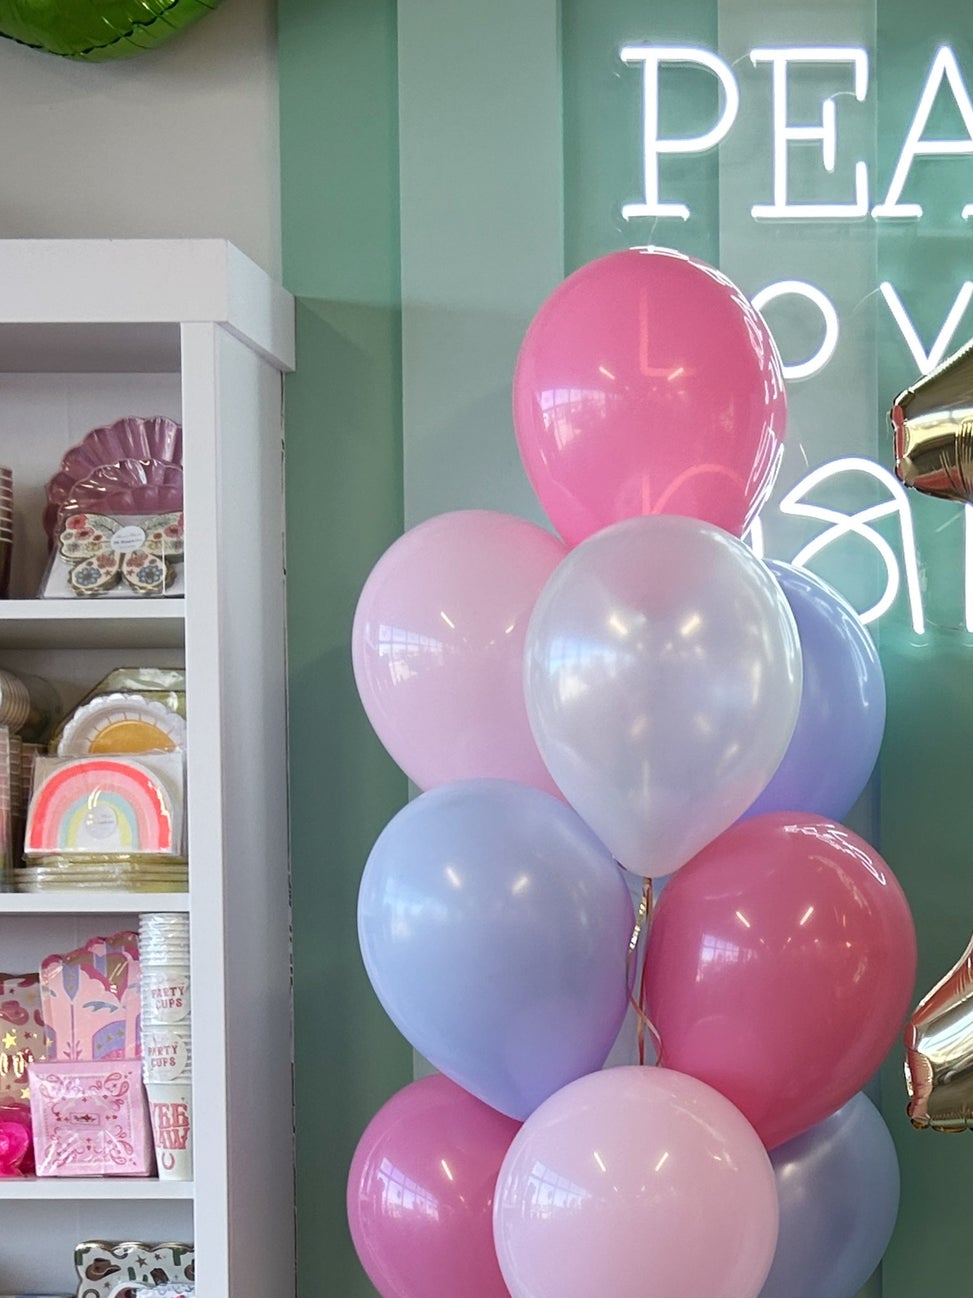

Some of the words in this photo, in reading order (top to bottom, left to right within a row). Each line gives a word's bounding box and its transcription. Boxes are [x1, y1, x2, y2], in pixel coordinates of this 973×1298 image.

[151, 986, 185, 999] PARTY
[156, 998, 183, 1009] CUPS
[148, 1044, 179, 1056] PARTY
[151, 1057, 176, 1068] CUPS
